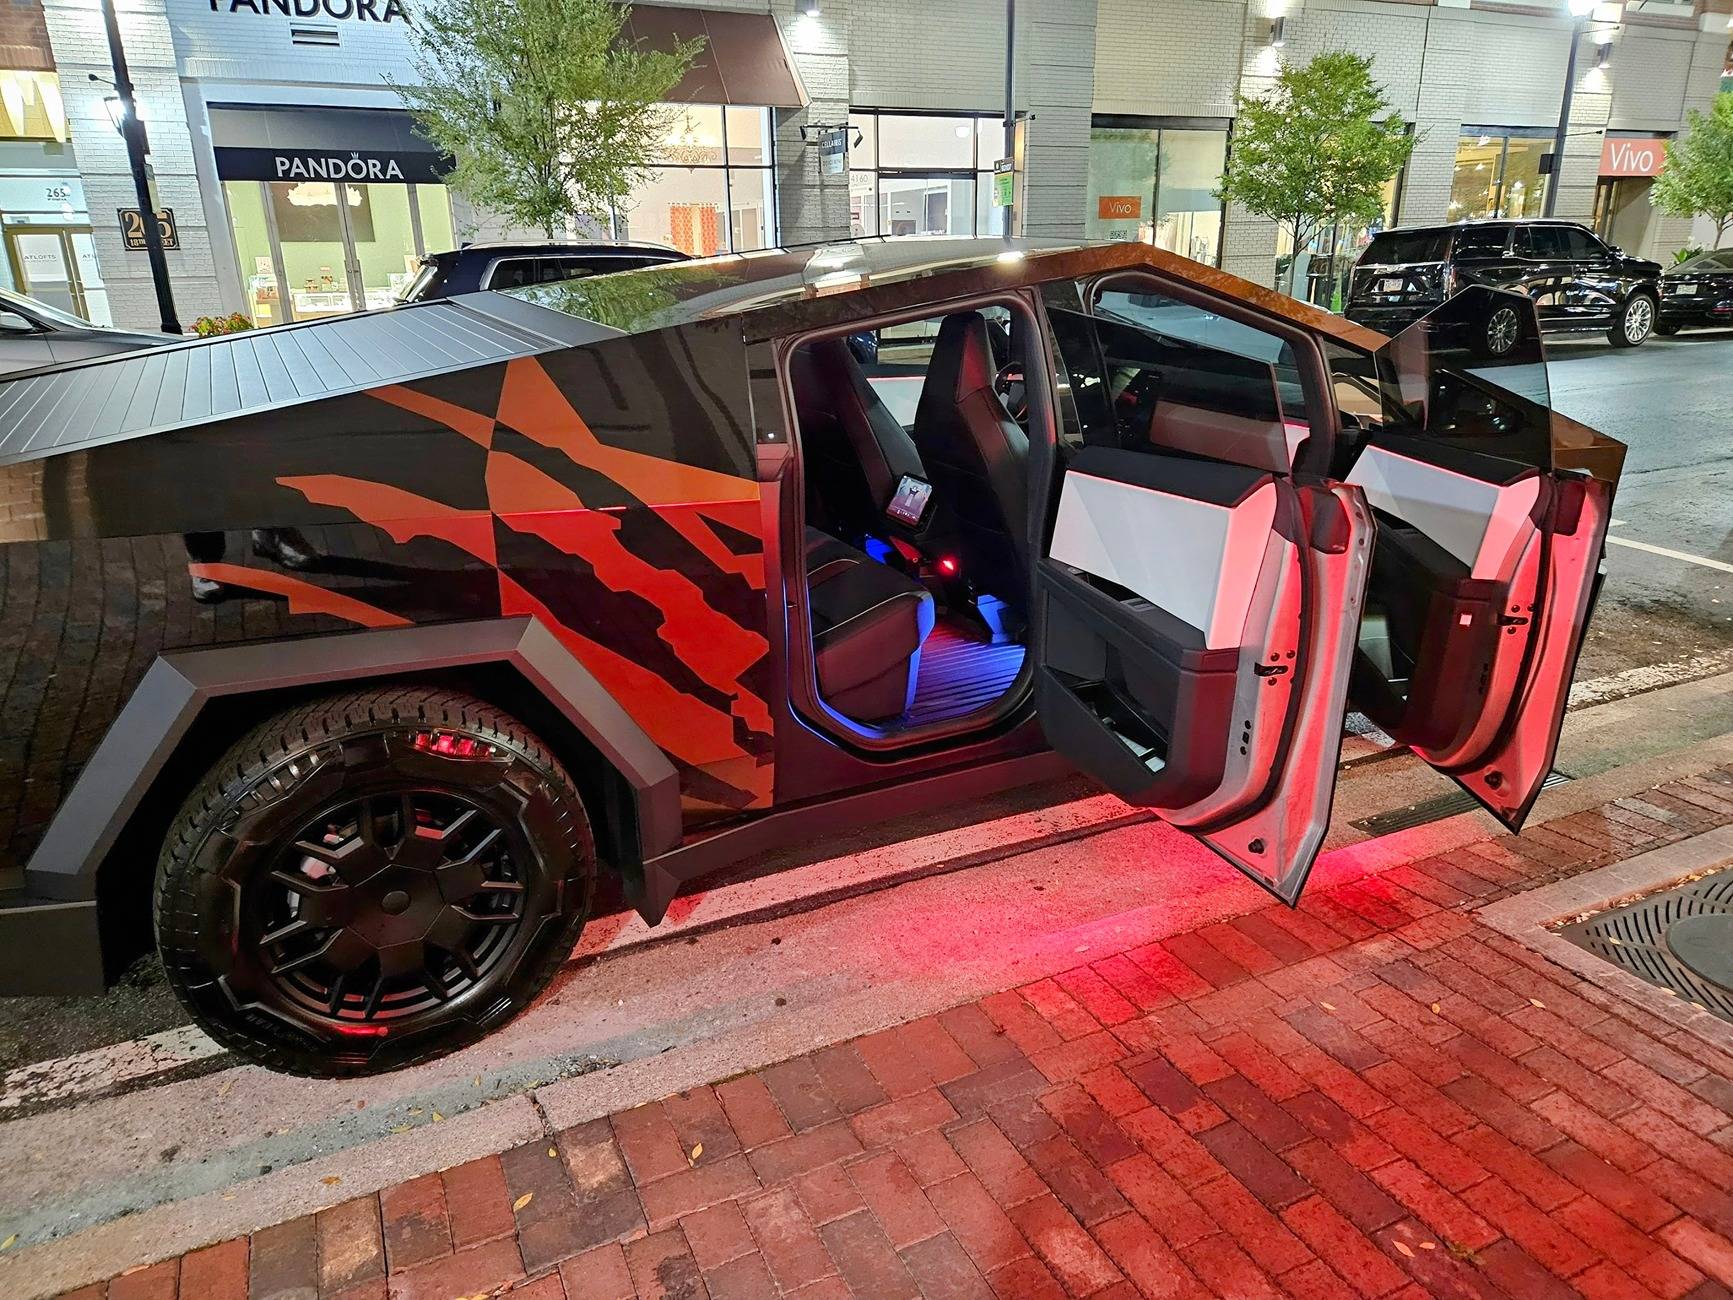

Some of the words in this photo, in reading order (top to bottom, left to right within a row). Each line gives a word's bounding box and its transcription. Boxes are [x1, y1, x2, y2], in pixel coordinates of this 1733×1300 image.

[1611, 143, 1653, 171] Vivo
[275, 156, 404, 179] PANDORA
[46, 188, 66, 198] 265
[1109, 200, 1131, 214] Vivo
